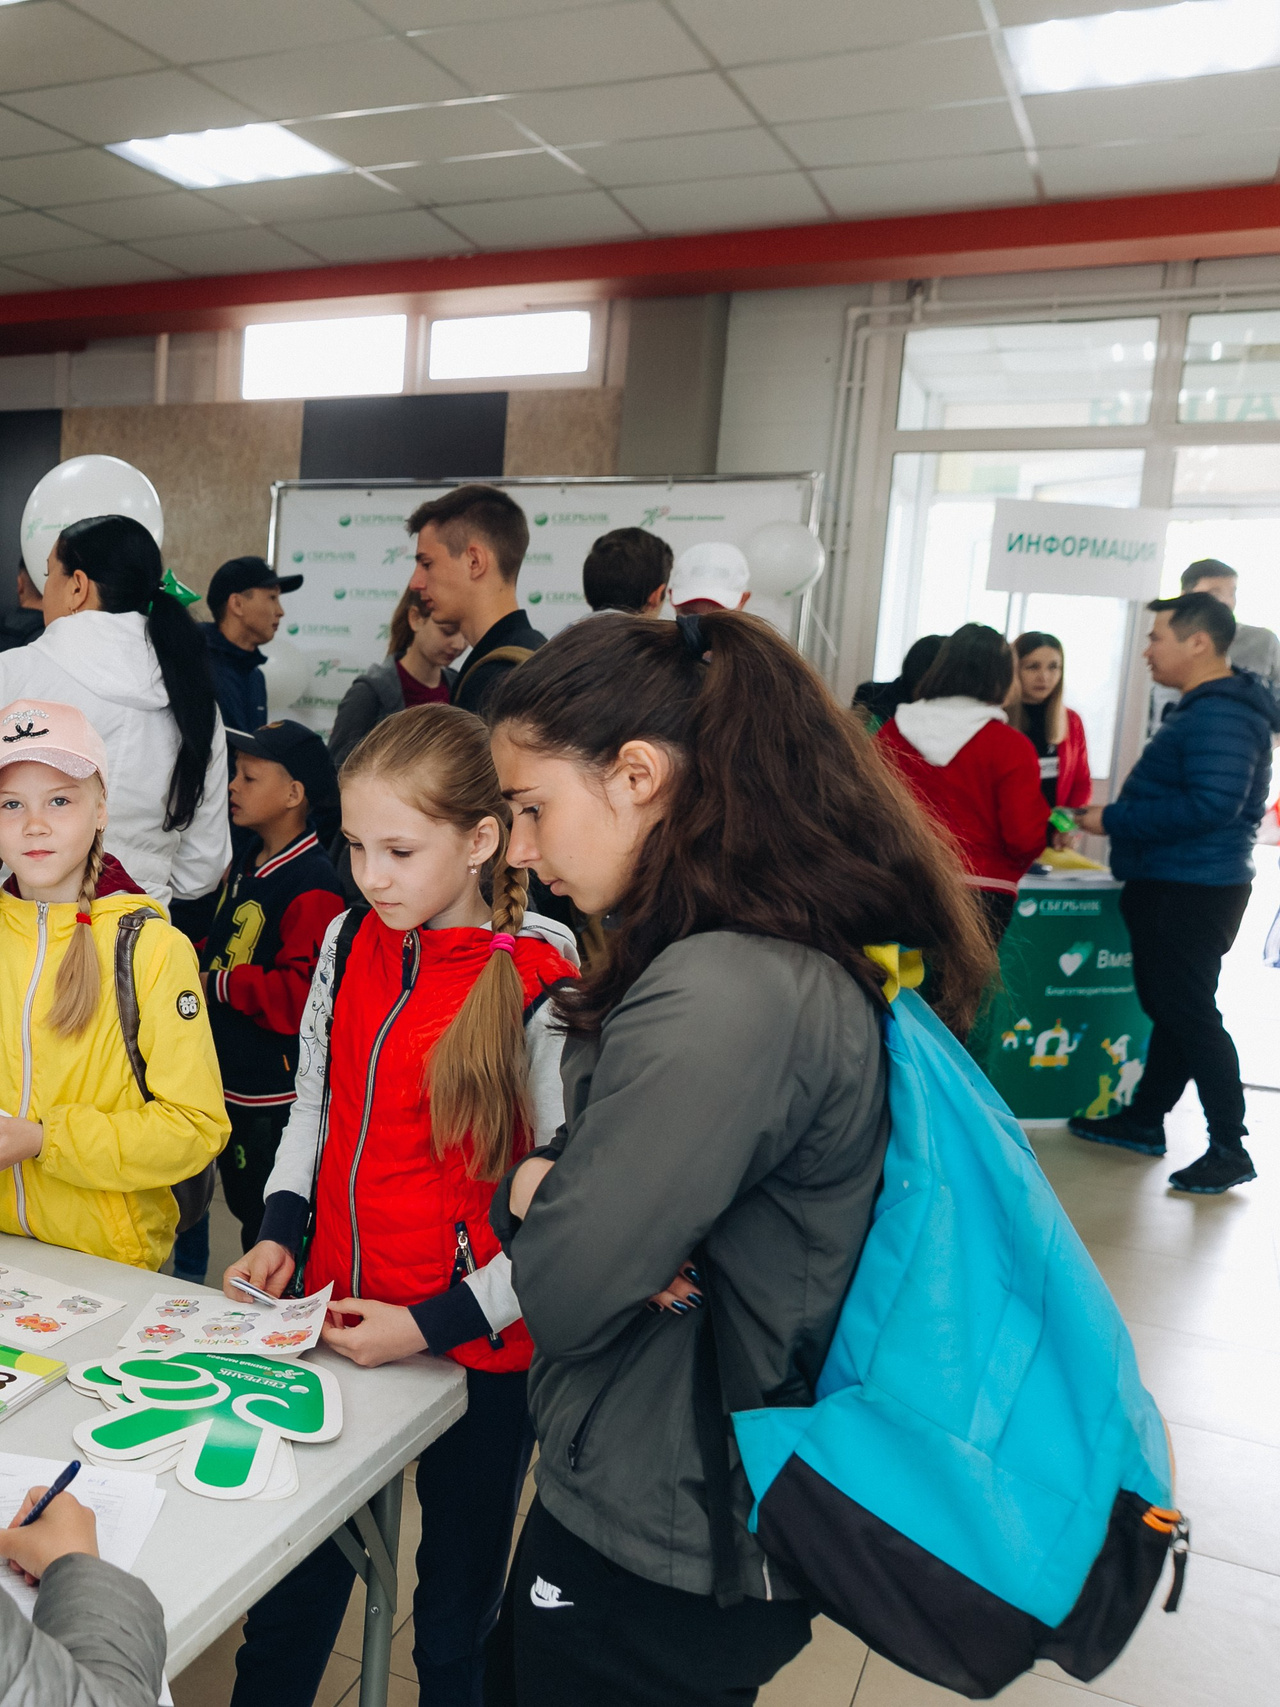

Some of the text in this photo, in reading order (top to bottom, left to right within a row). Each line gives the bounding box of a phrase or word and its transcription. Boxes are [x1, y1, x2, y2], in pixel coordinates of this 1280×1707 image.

[1006, 532, 1158, 563] ИНФОРМАЦИЯ
[1097, 949, 1133, 969] Вме
[217, 1369, 287, 1389] СБЕРБАНК
